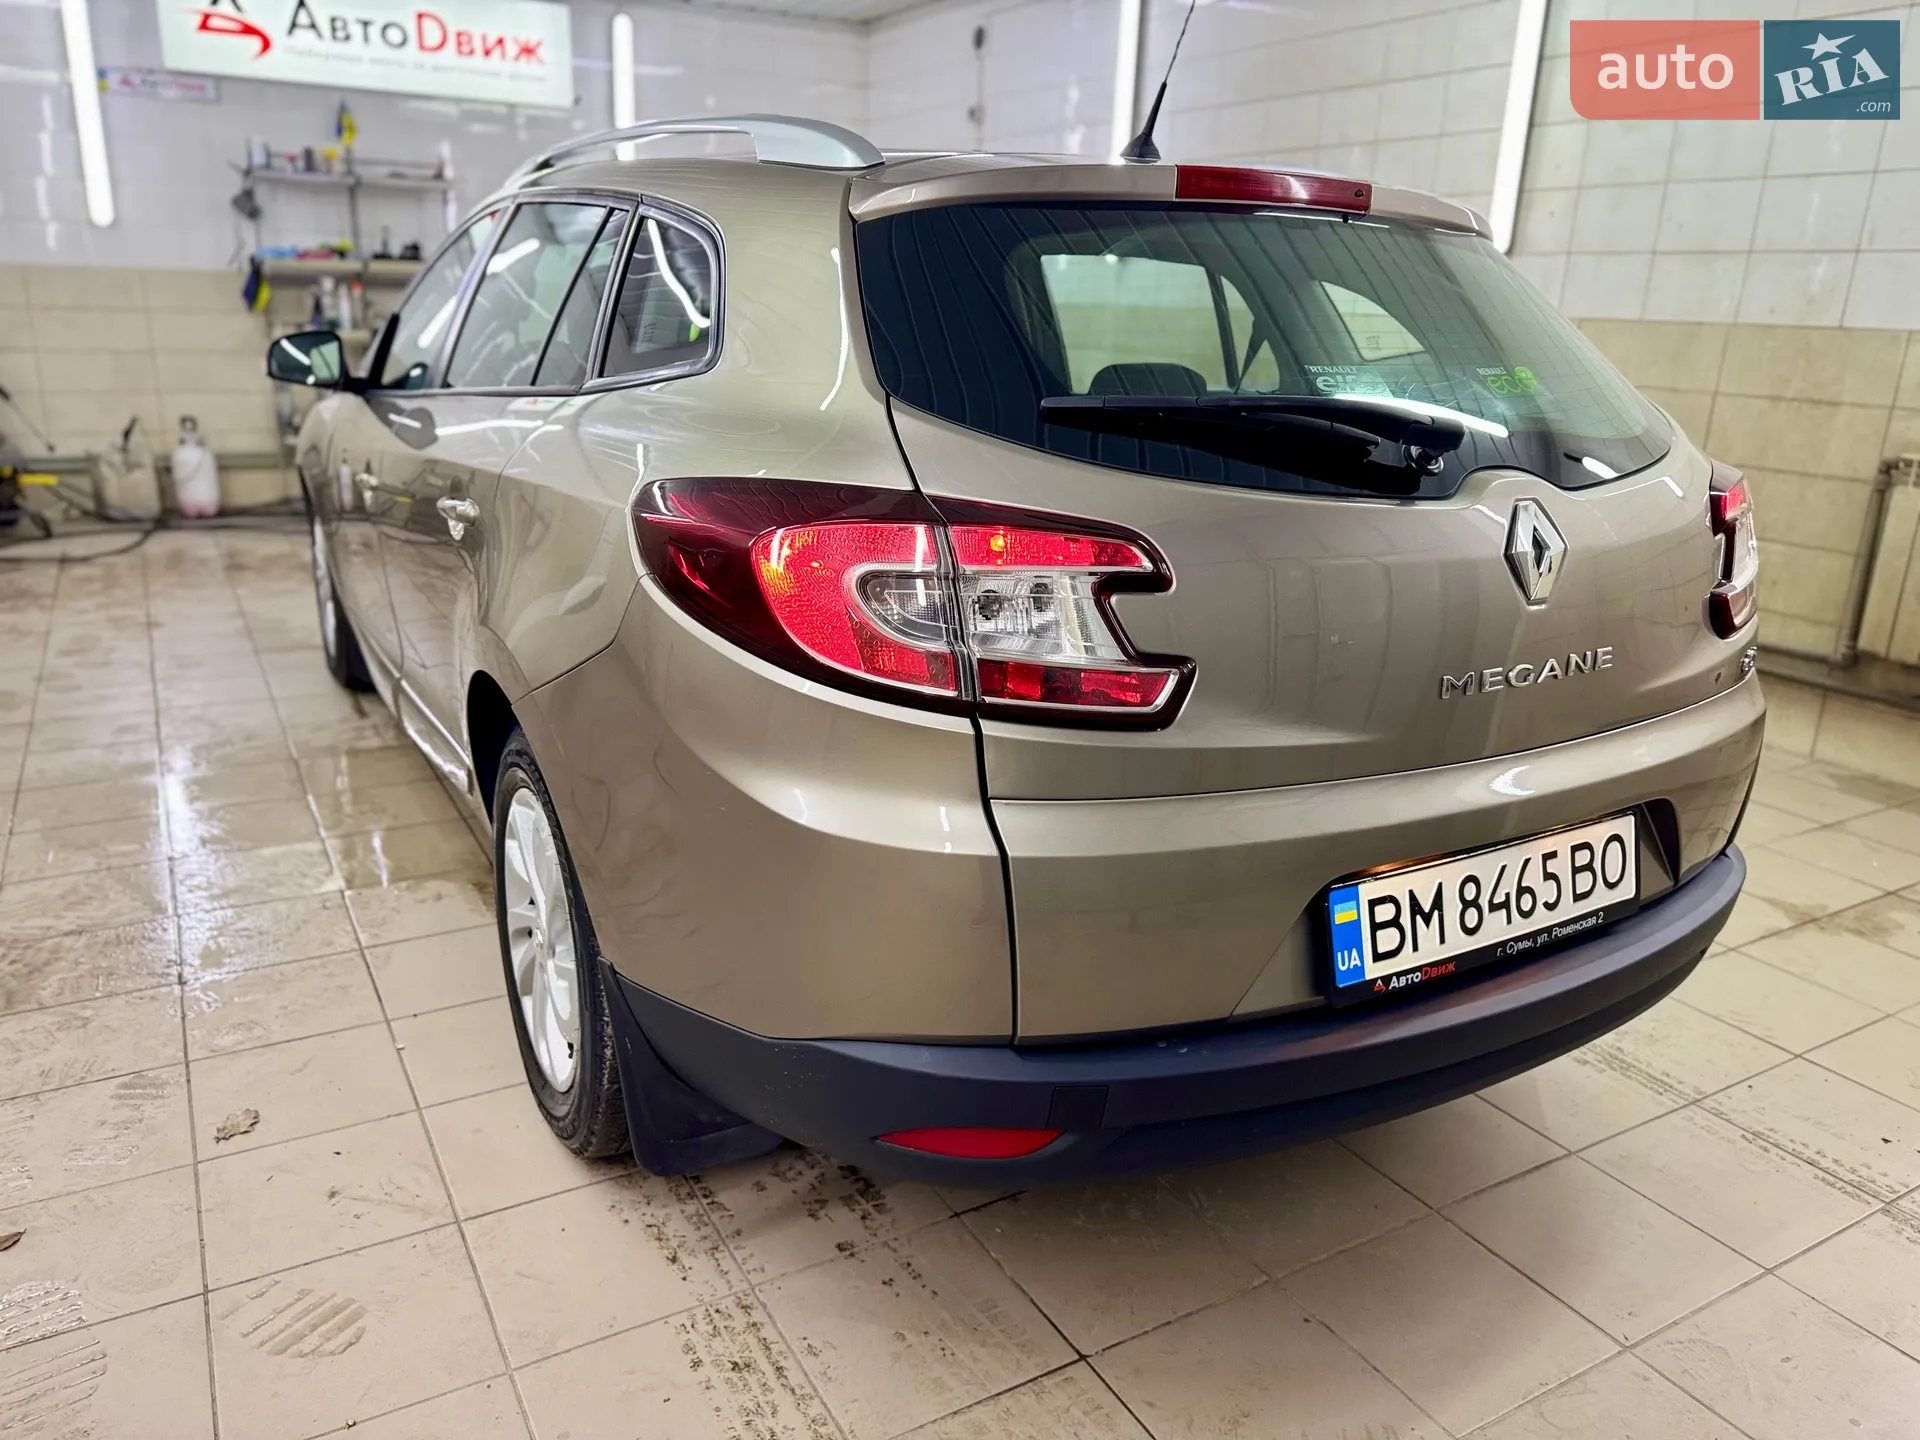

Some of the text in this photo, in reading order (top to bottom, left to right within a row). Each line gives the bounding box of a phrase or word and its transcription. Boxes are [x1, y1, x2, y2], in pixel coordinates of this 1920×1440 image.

[1440, 646, 1614, 700] MEGANE
[1506, 938, 1534, 955] Сумы,
[1536, 931, 1550, 947] ул.
[1552, 915, 1597, 940] Роменская
[1597, 911, 1604, 924] 2
[1337, 948, 1361, 971] UA
